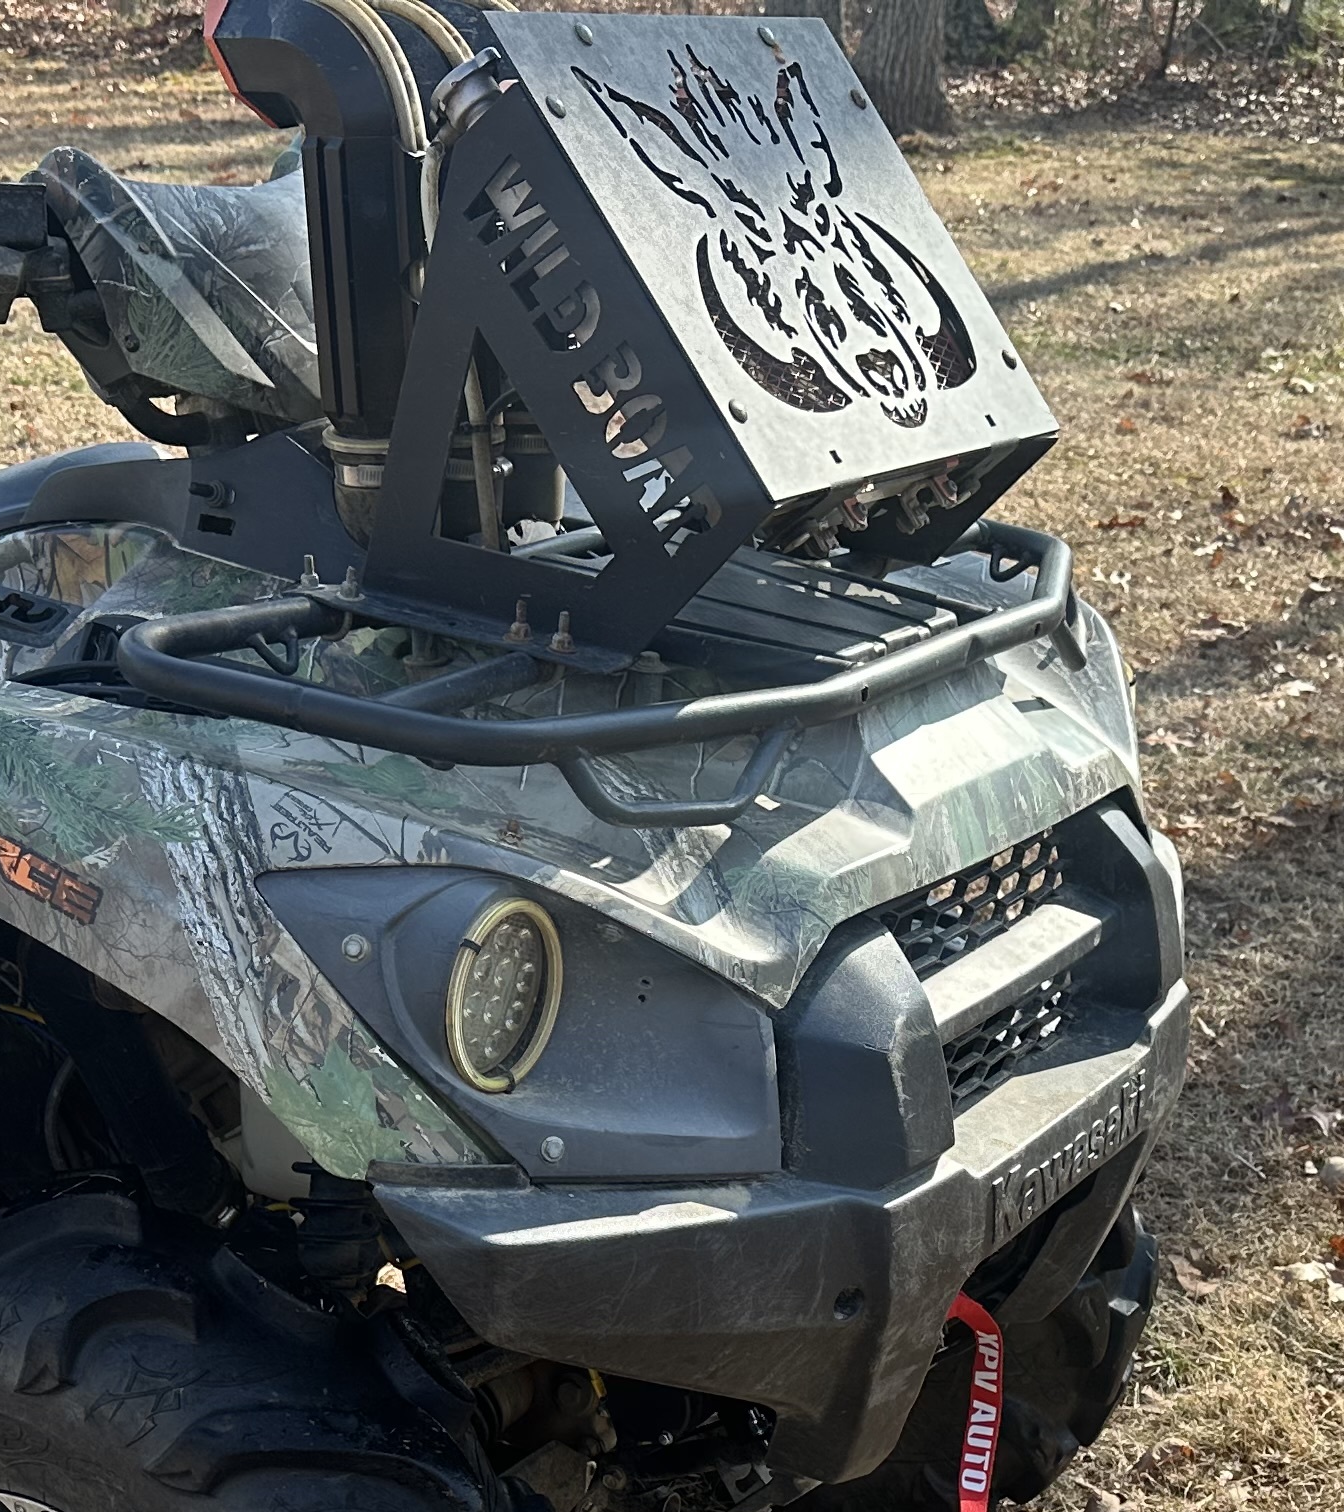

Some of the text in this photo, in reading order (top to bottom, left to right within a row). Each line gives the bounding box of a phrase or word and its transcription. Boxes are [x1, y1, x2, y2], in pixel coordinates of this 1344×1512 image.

[463, 154, 722, 558] WILD BOAR
[991, 1068, 1146, 1245] Kawasaki
[961, 1330, 999, 1493] XPV AUTO
